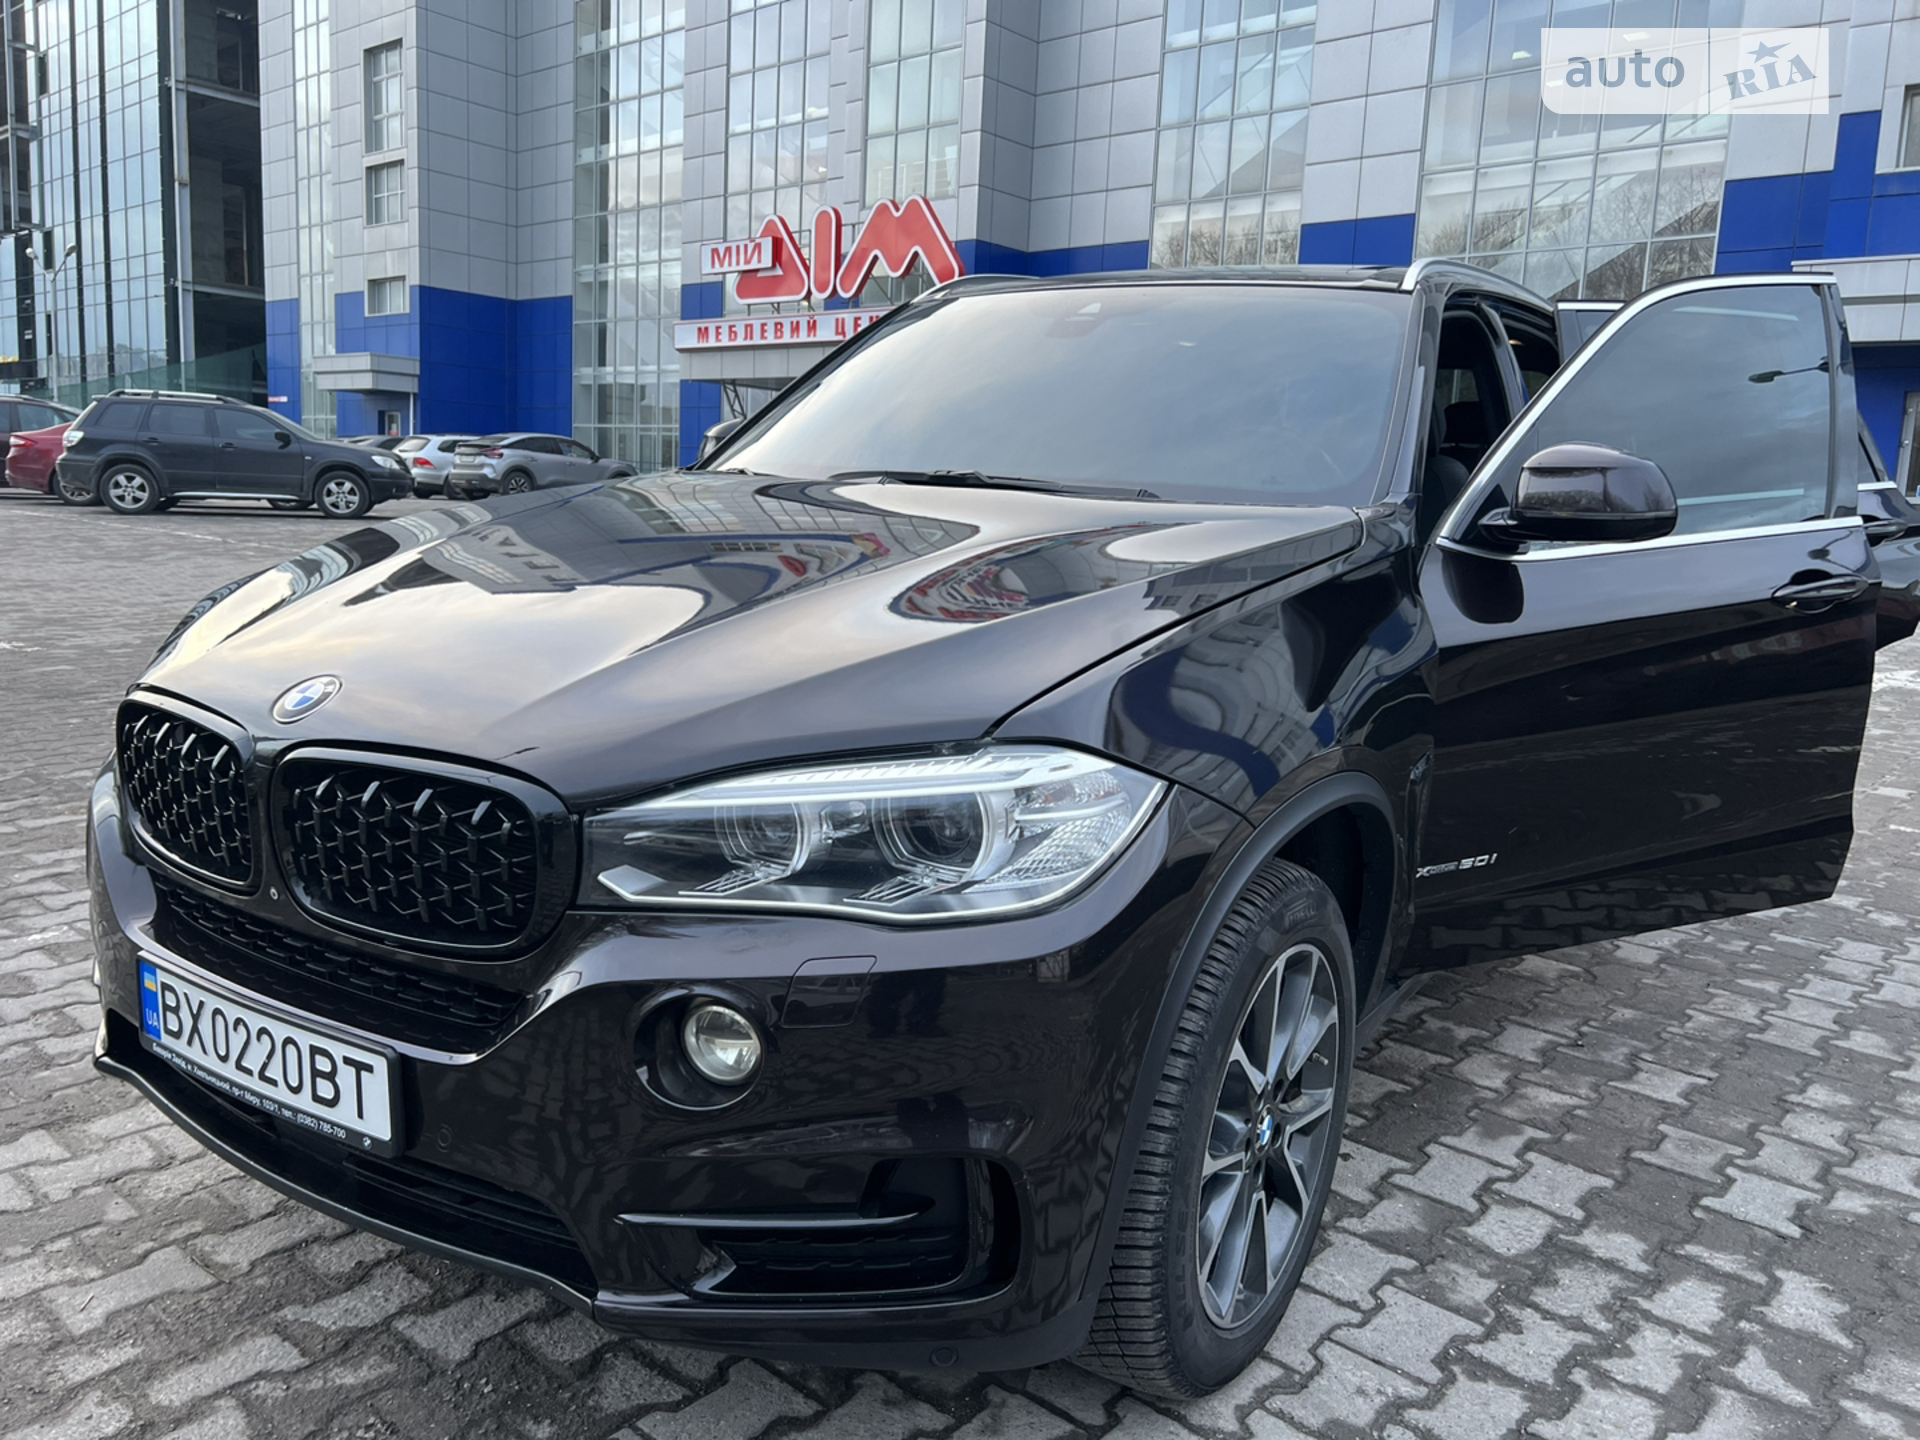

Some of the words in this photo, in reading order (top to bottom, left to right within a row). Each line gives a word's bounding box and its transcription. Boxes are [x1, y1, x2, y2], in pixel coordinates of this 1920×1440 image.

[711, 239, 762, 270] МІЙ
[696, 315, 818, 344] МЕБЛЕВИЙ
[146, 1007, 159, 1029] UA
